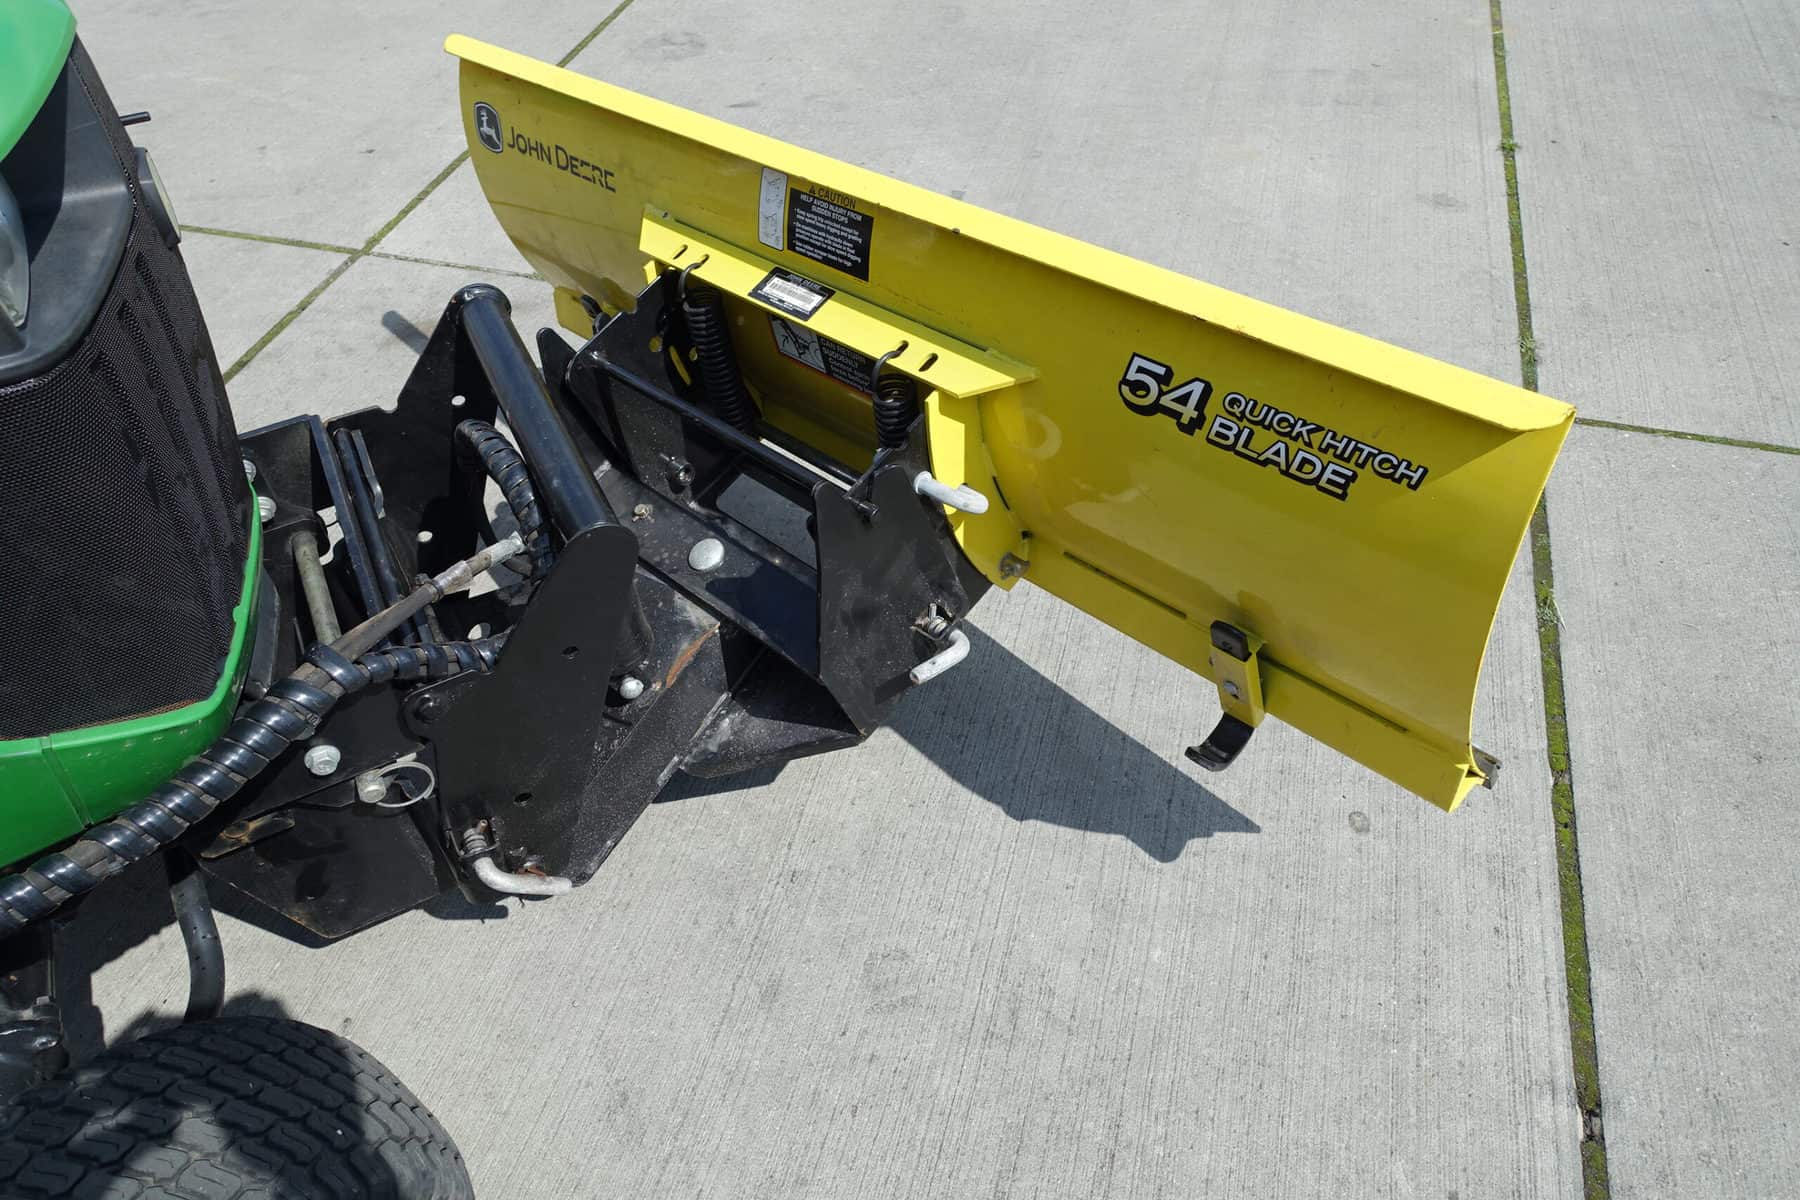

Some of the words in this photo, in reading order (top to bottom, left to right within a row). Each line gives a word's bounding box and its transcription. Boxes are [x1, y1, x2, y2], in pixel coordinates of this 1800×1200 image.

[507, 126, 552, 165] JOHN
[800, 193, 813, 203] HELP
[813, 198, 828, 208] AVOID
[829, 204, 847, 215] INJURY
[847, 210, 862, 221] FROM
[811, 205, 831, 217] SUDDEN
[831, 213, 848, 224] STOPS
[818, 187, 856, 209] CAUTION
[1119, 352, 1213, 436] 54
[1206, 415, 1358, 502] BLADE
[1222, 391, 1325, 449] QUICK
[1318, 427, 1429, 491] HITCH
